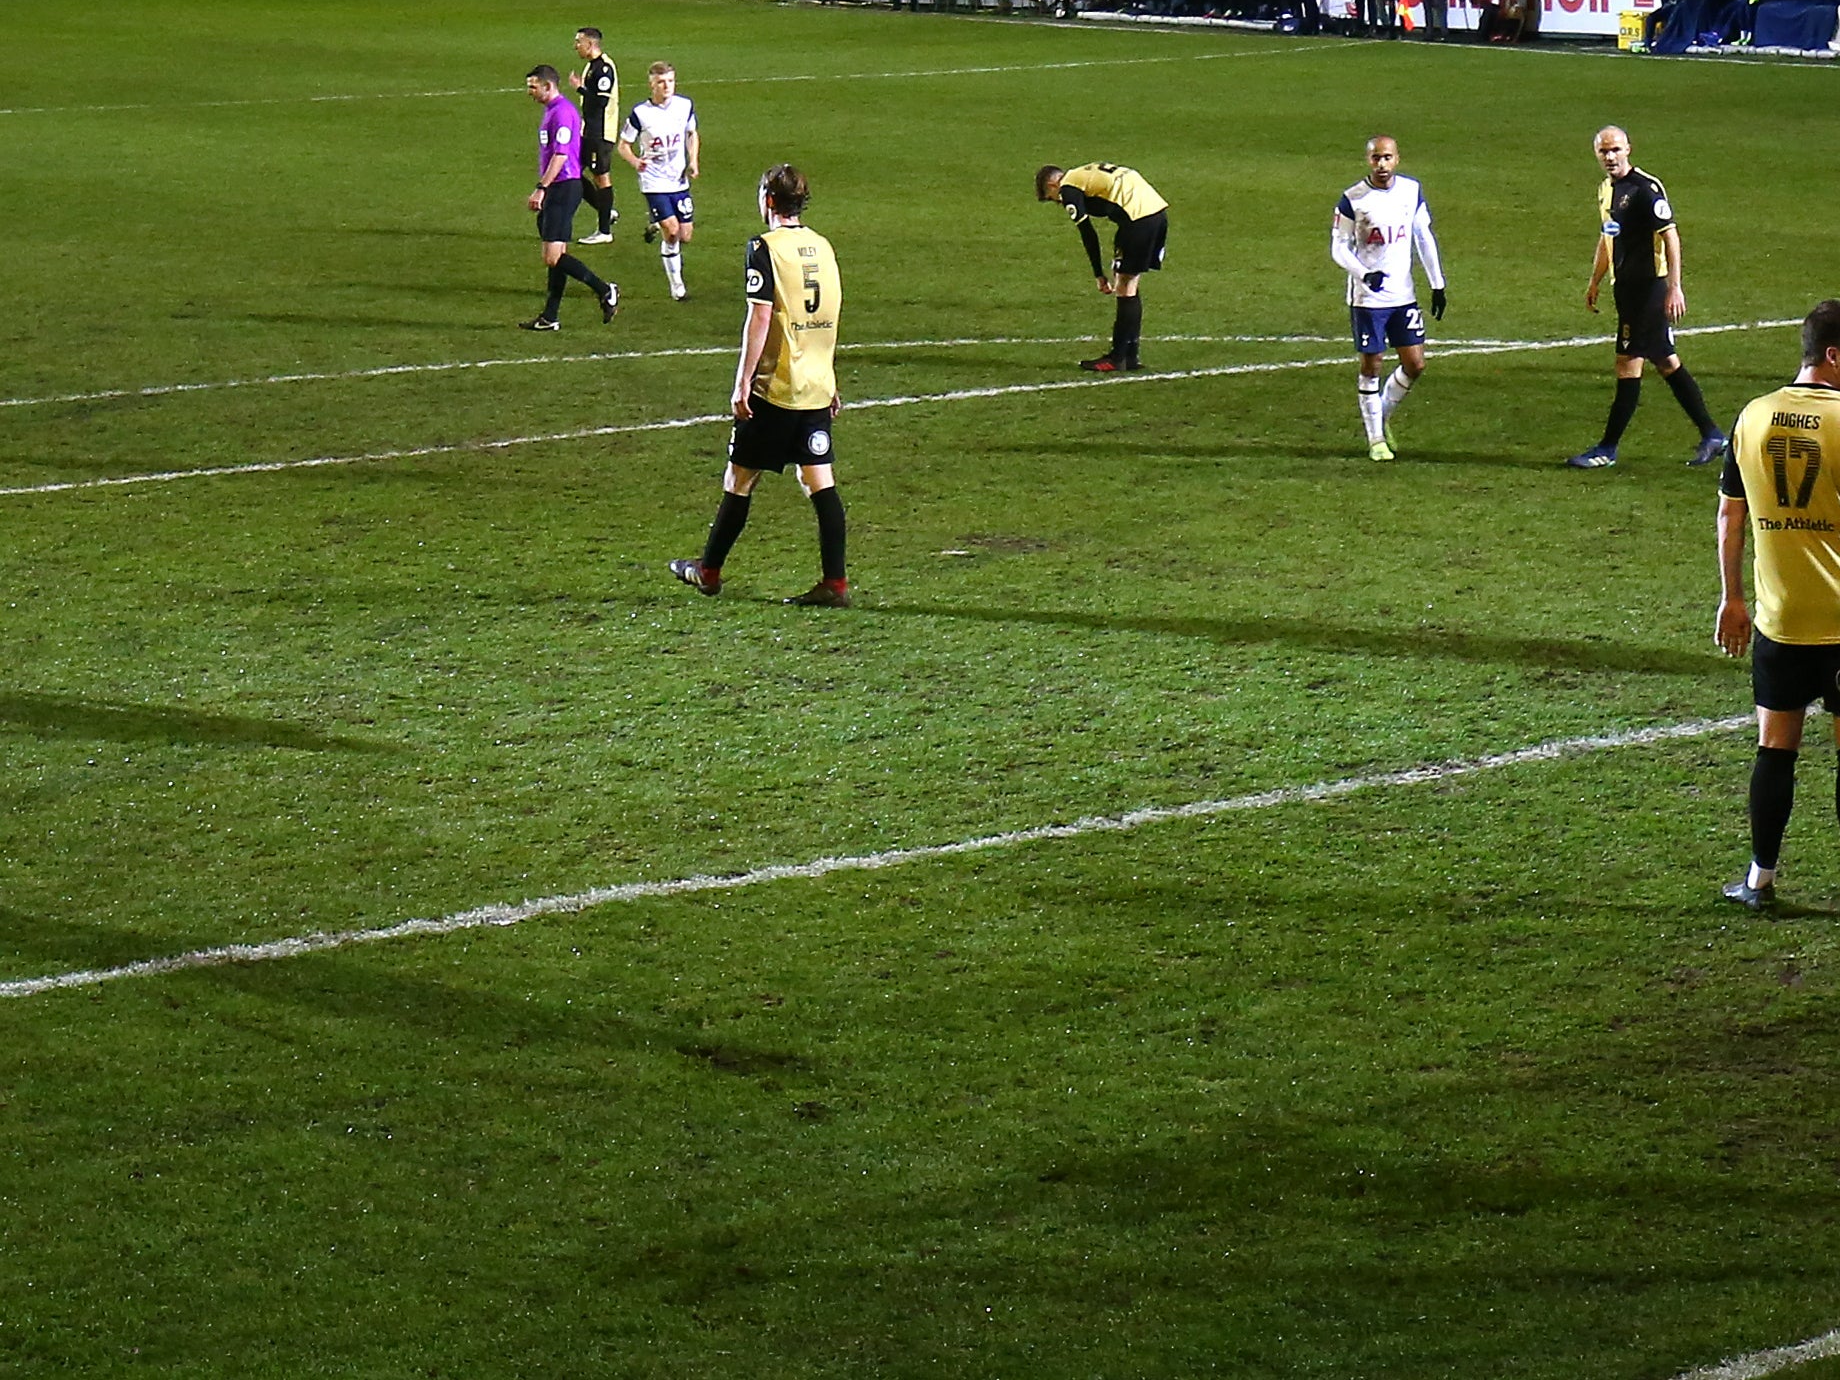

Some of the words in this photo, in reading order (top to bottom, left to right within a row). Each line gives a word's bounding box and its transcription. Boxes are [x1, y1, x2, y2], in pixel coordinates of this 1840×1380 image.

[650, 133, 681, 149] AIA
[1366, 224, 1408, 245] AIA
[801, 263, 820, 314] 5
[1771, 411, 1821, 431] HUGHES
[1766, 436, 1822, 509] 17
[1758, 518, 1783, 531] The
[1784, 517, 1835, 532] Athletic
